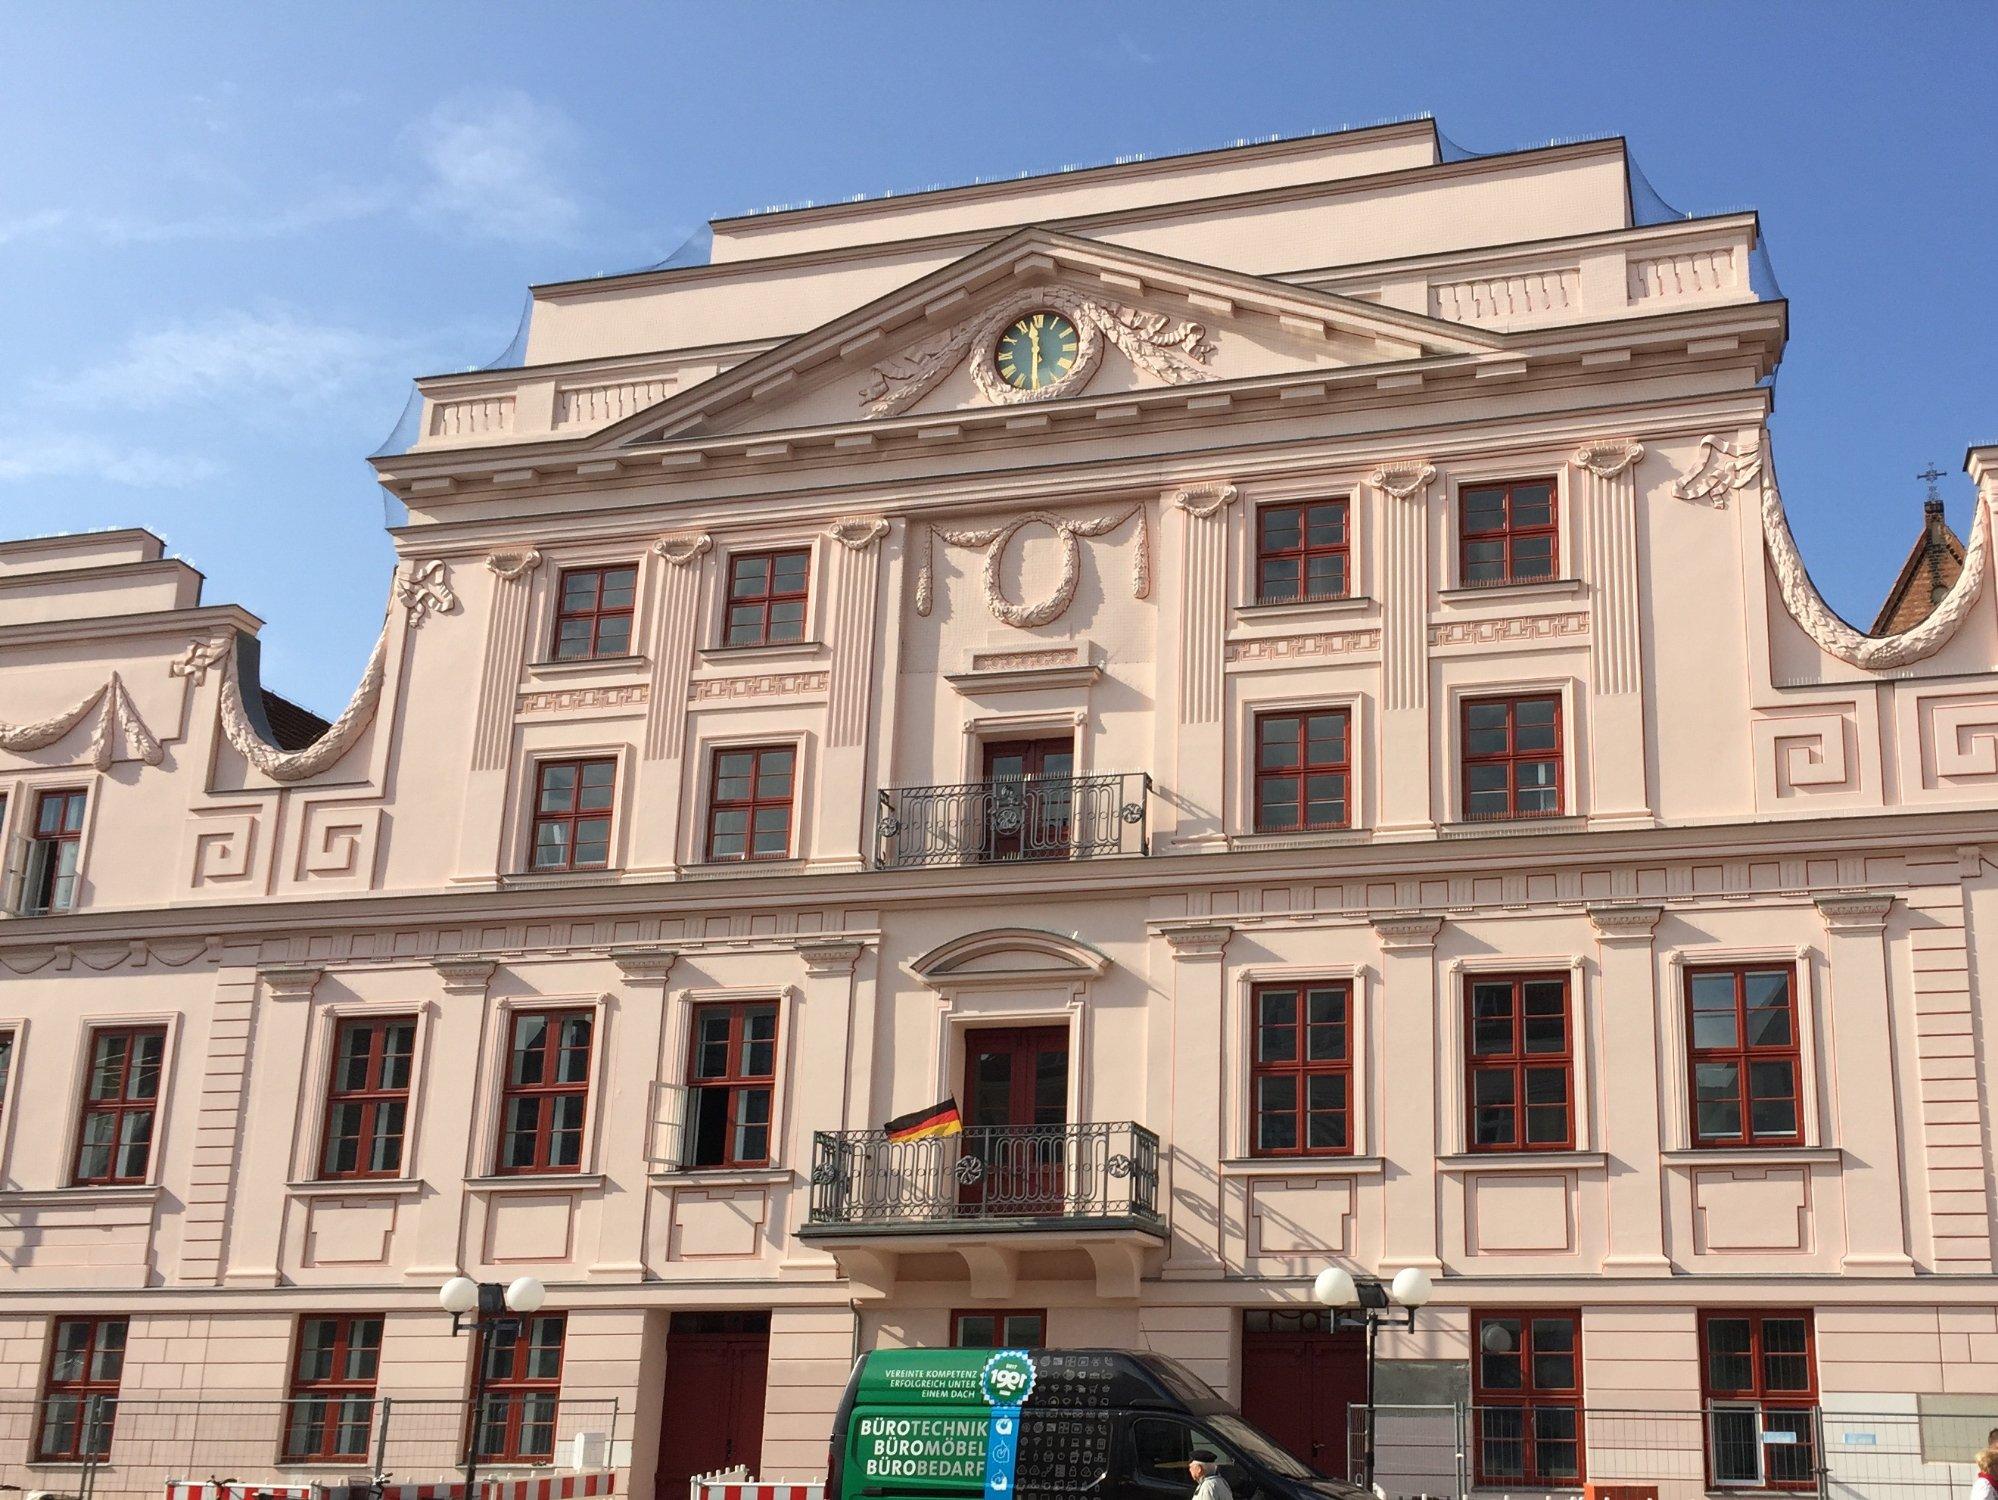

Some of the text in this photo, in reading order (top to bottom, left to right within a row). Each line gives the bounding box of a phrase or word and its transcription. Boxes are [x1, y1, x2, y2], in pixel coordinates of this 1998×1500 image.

[1002, 335, 1018, 346] X
[885, 1369, 978, 1379] VEREINTE KOMPETENZ
[890, 1379, 976, 1389] ERFOLGREICH UNTER
[921, 1389, 975, 1398] EINEM DACH
[860, 1417, 989, 1437] BÜROTECHNIK
[874, 1436, 986, 1456] BÜROMÖBEL
[866, 1456, 986, 1477] BÜROBEDARF
